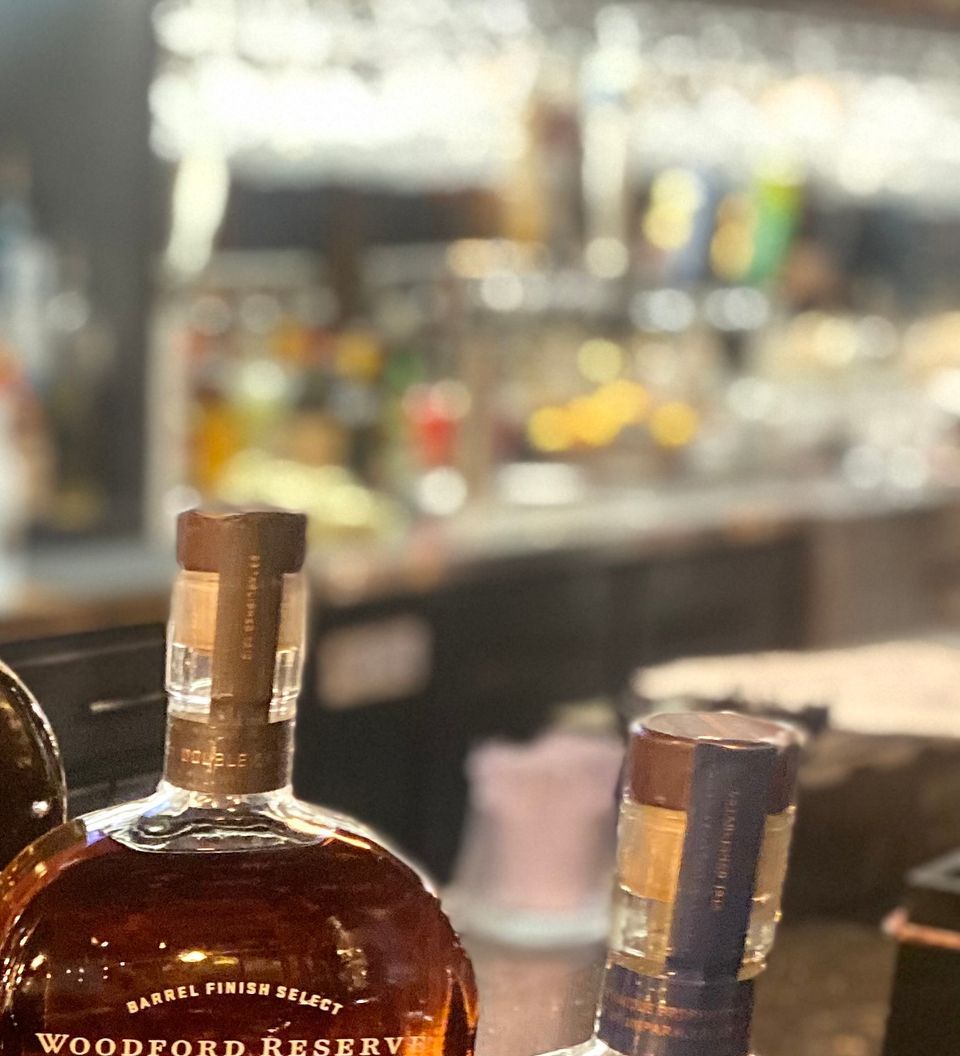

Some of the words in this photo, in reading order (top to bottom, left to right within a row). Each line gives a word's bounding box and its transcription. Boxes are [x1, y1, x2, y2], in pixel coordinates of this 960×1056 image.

[126, 984, 200, 1015] BARREL
[205, 981, 270, 997] FINISH
[275, 985, 344, 1016] SELECT
